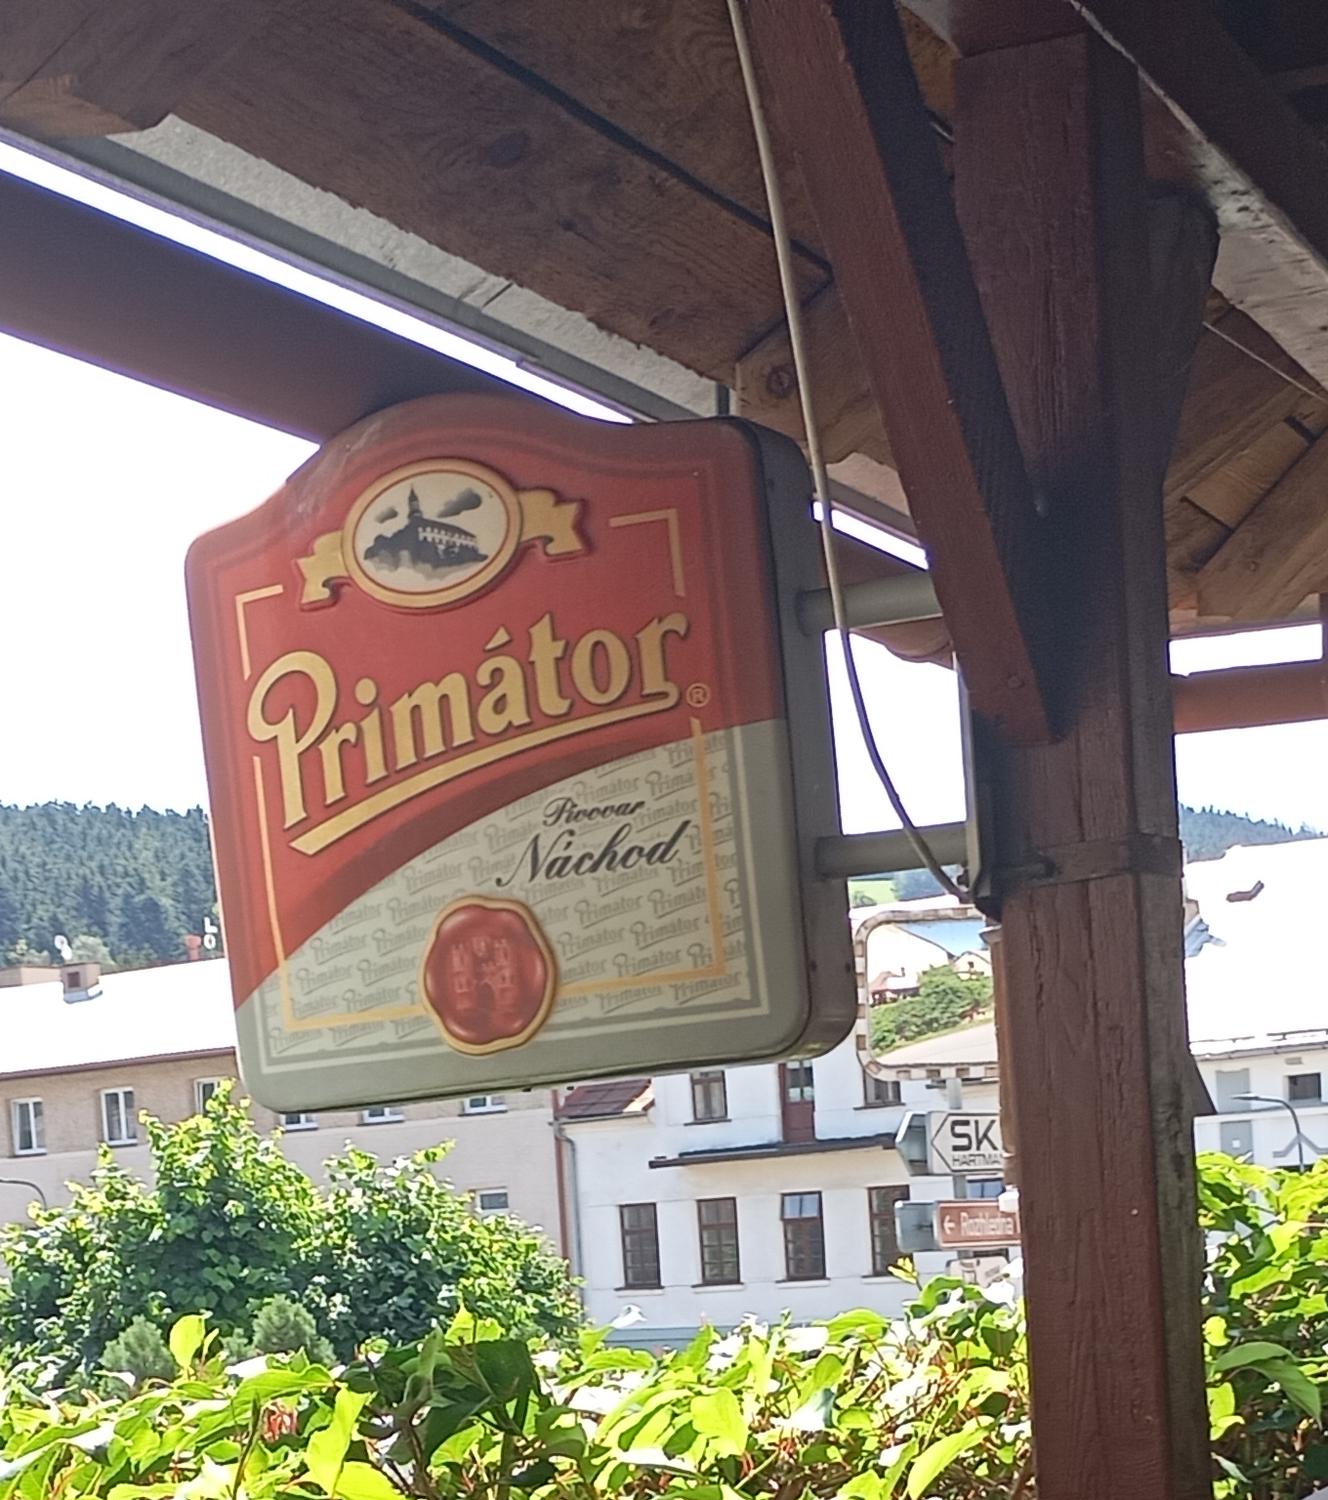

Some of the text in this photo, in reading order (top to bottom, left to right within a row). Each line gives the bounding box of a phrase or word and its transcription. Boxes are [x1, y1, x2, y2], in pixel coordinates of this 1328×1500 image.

[247, 612, 689, 830] Primátor
[542, 797, 646, 827] Pivovar
[496, 819, 692, 888] Náchod
[952, 1153, 1003, 1167] HARTMA
